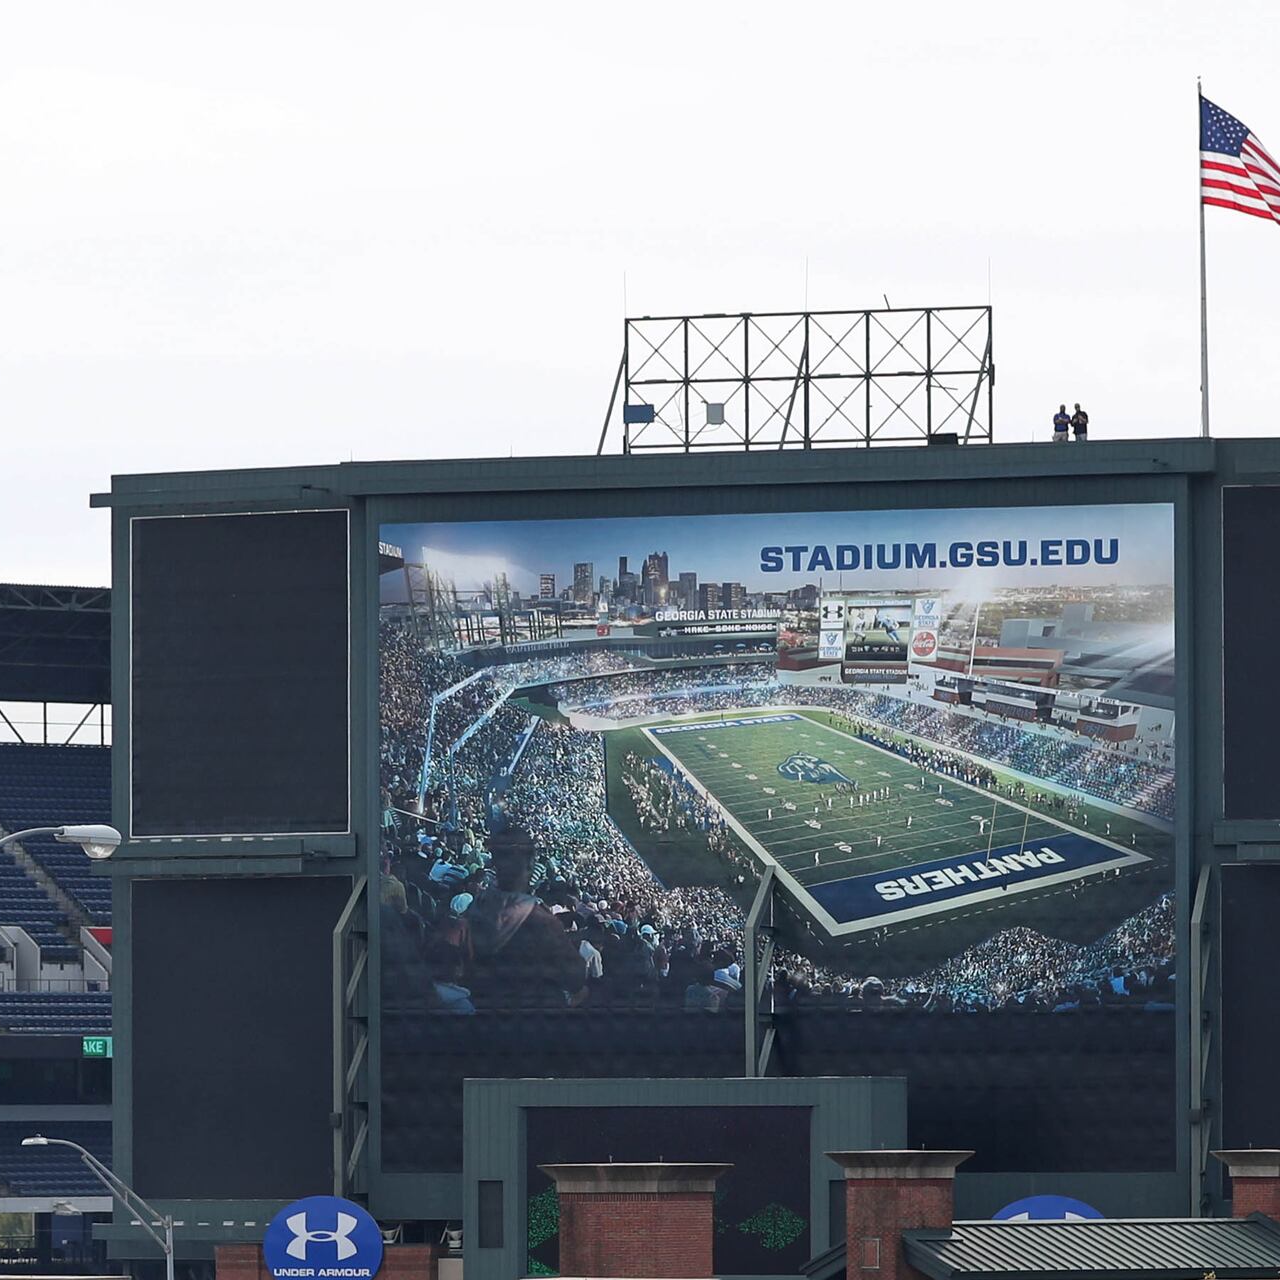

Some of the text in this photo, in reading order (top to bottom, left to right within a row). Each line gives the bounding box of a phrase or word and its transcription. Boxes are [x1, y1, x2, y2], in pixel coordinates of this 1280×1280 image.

[760, 538, 1119, 572] STADIUM.GSU.EDU
[655, 608, 781, 622] GEORGIA STATE STADIUM
[655, 713, 795, 735] GEORGIA STATE
[874, 846, 1067, 902] PANTHERS
[273, 1268, 371, 1277] UNDER ARMOUR
